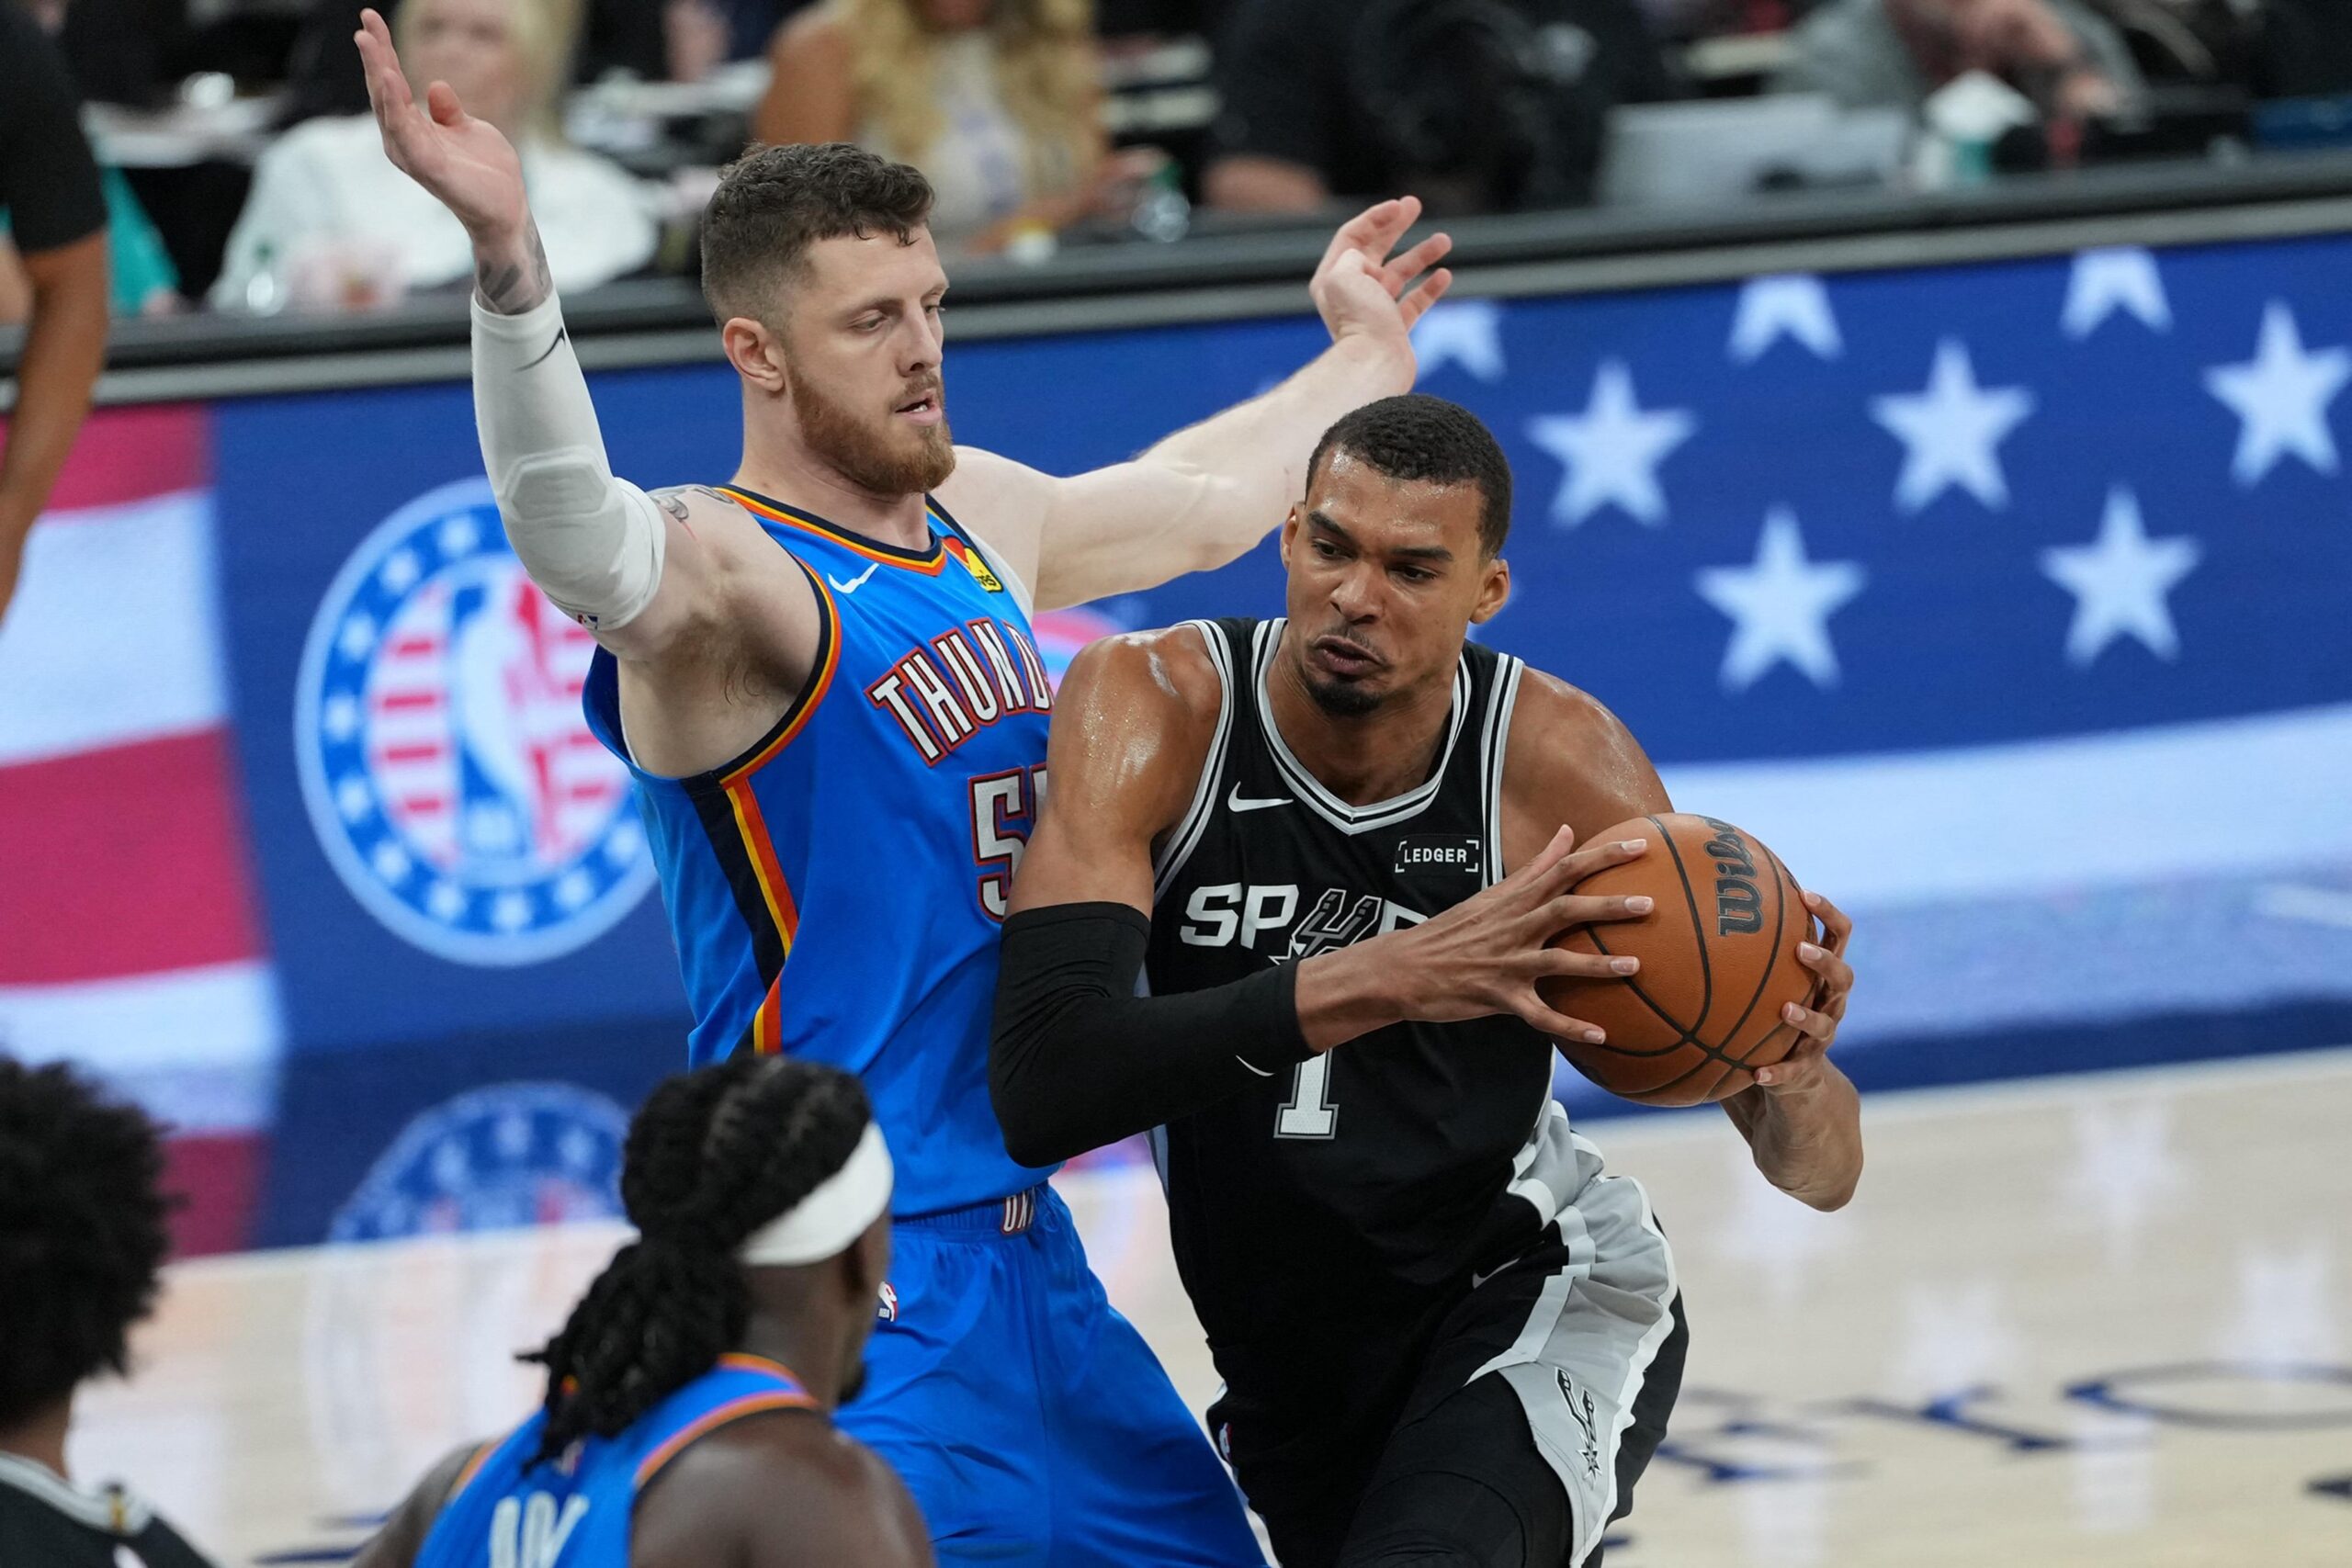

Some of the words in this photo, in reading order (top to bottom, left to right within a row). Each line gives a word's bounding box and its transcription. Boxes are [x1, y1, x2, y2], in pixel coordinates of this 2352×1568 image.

[968, 763, 1047, 922] 5
[1404, 848, 1467, 863] LEDGER
[1273, 1047, 1340, 1139] 1
